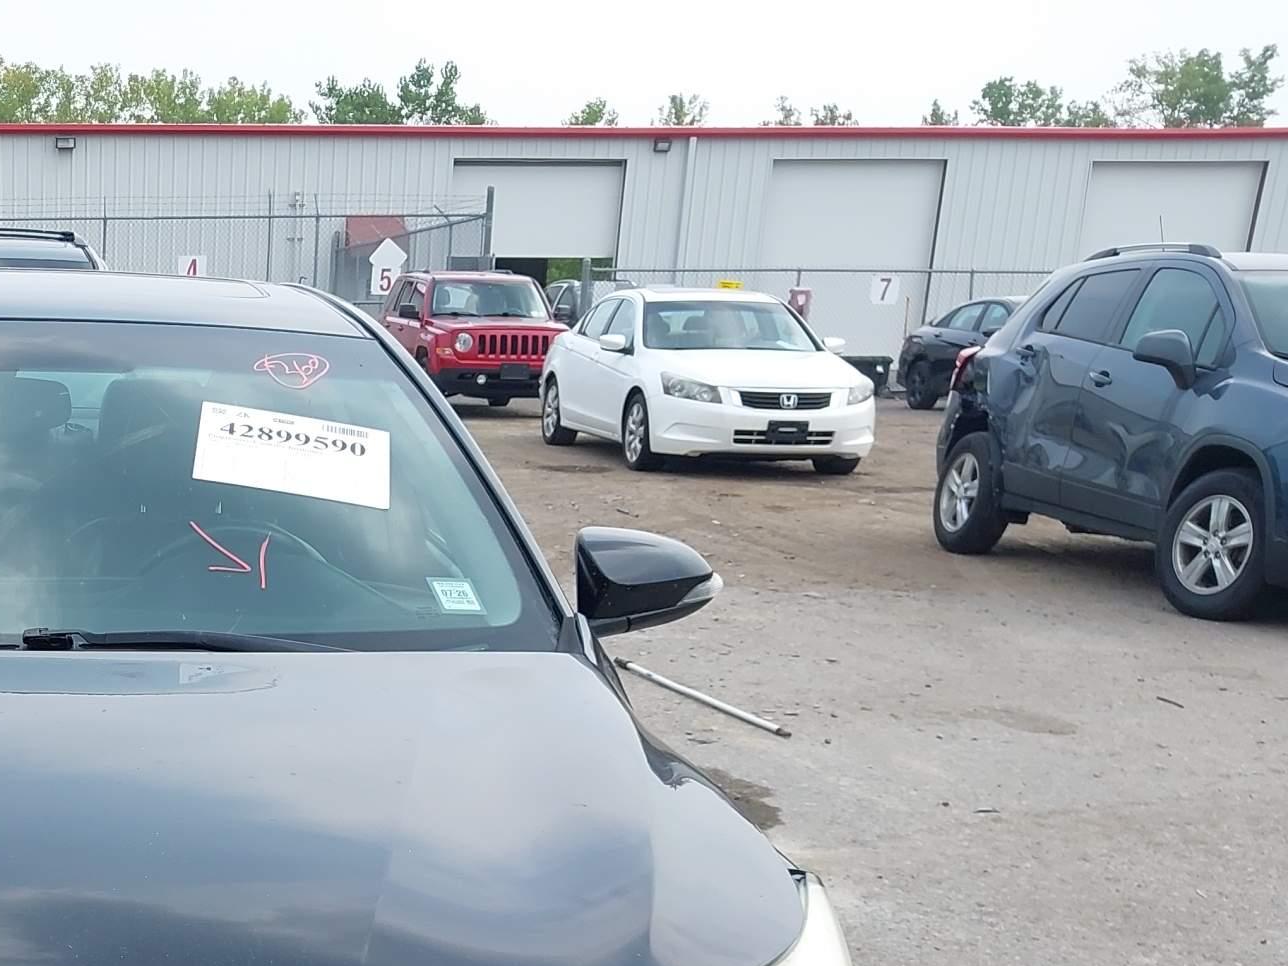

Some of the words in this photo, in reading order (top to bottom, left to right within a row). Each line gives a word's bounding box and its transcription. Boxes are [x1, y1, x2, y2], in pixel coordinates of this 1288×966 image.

[379, 268, 393, 292] 5
[879, 278, 892, 301] 7
[219, 421, 367, 457] 42899590
